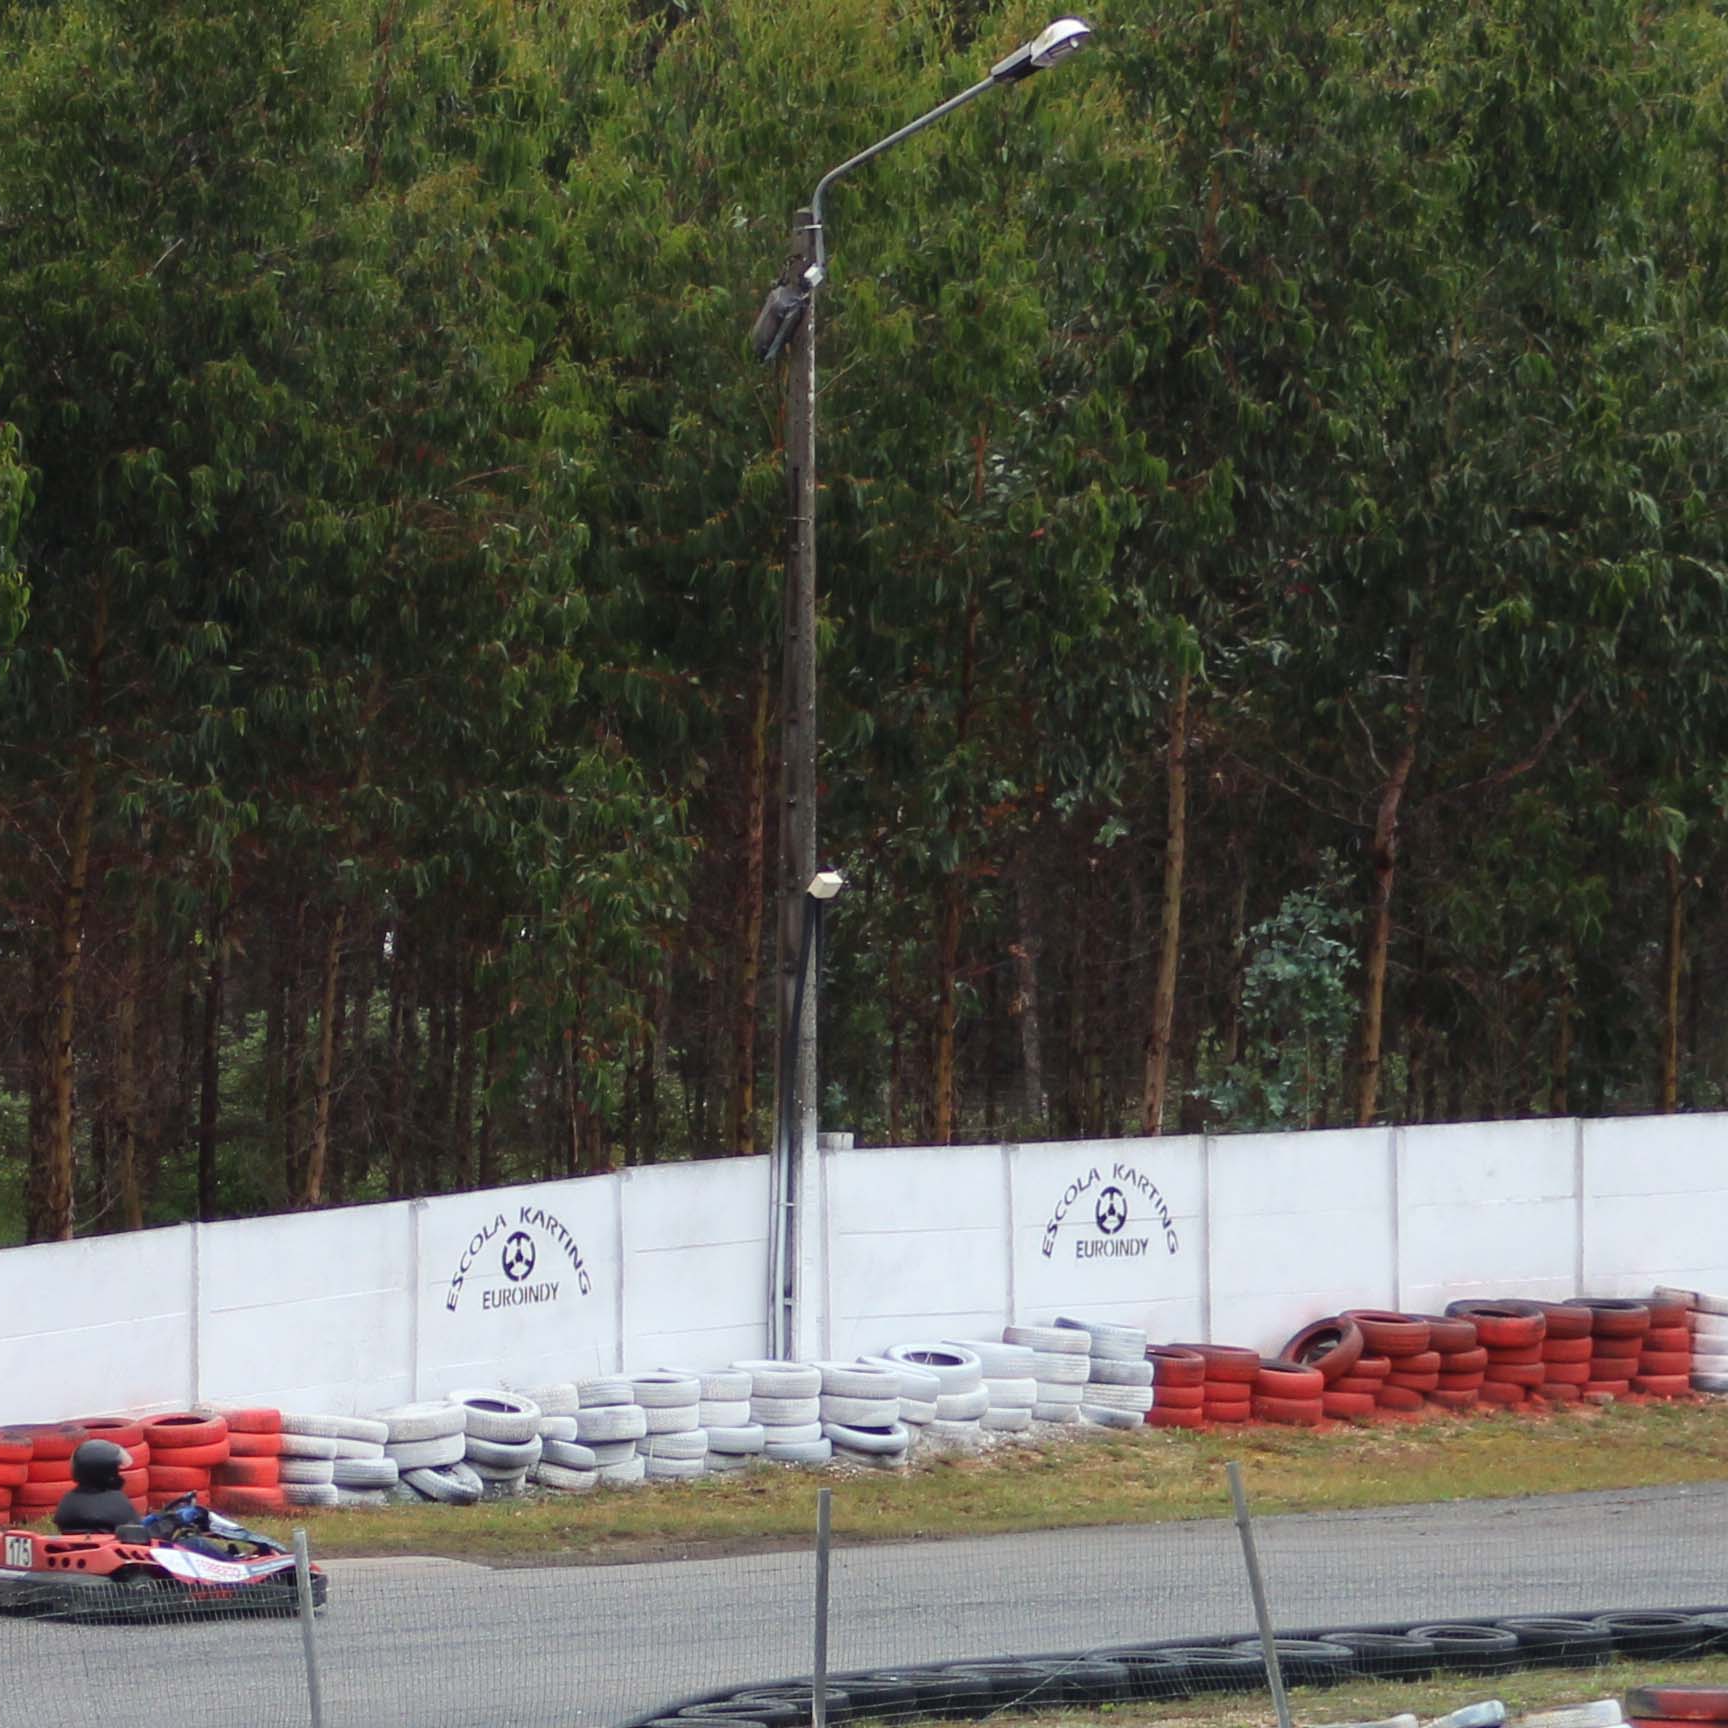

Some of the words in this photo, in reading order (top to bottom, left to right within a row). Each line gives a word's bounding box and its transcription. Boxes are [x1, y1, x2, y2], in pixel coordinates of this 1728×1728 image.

[1042, 1168, 1101, 1258] ESCOLA
[1113, 1163, 1179, 1255] KARTING
[446, 1213, 507, 1312] ESCOLA
[520, 1206, 591, 1296] KARTING
[1076, 1238, 1149, 1259] EUROINDY
[482, 1282, 560, 1310] EUROINDY
